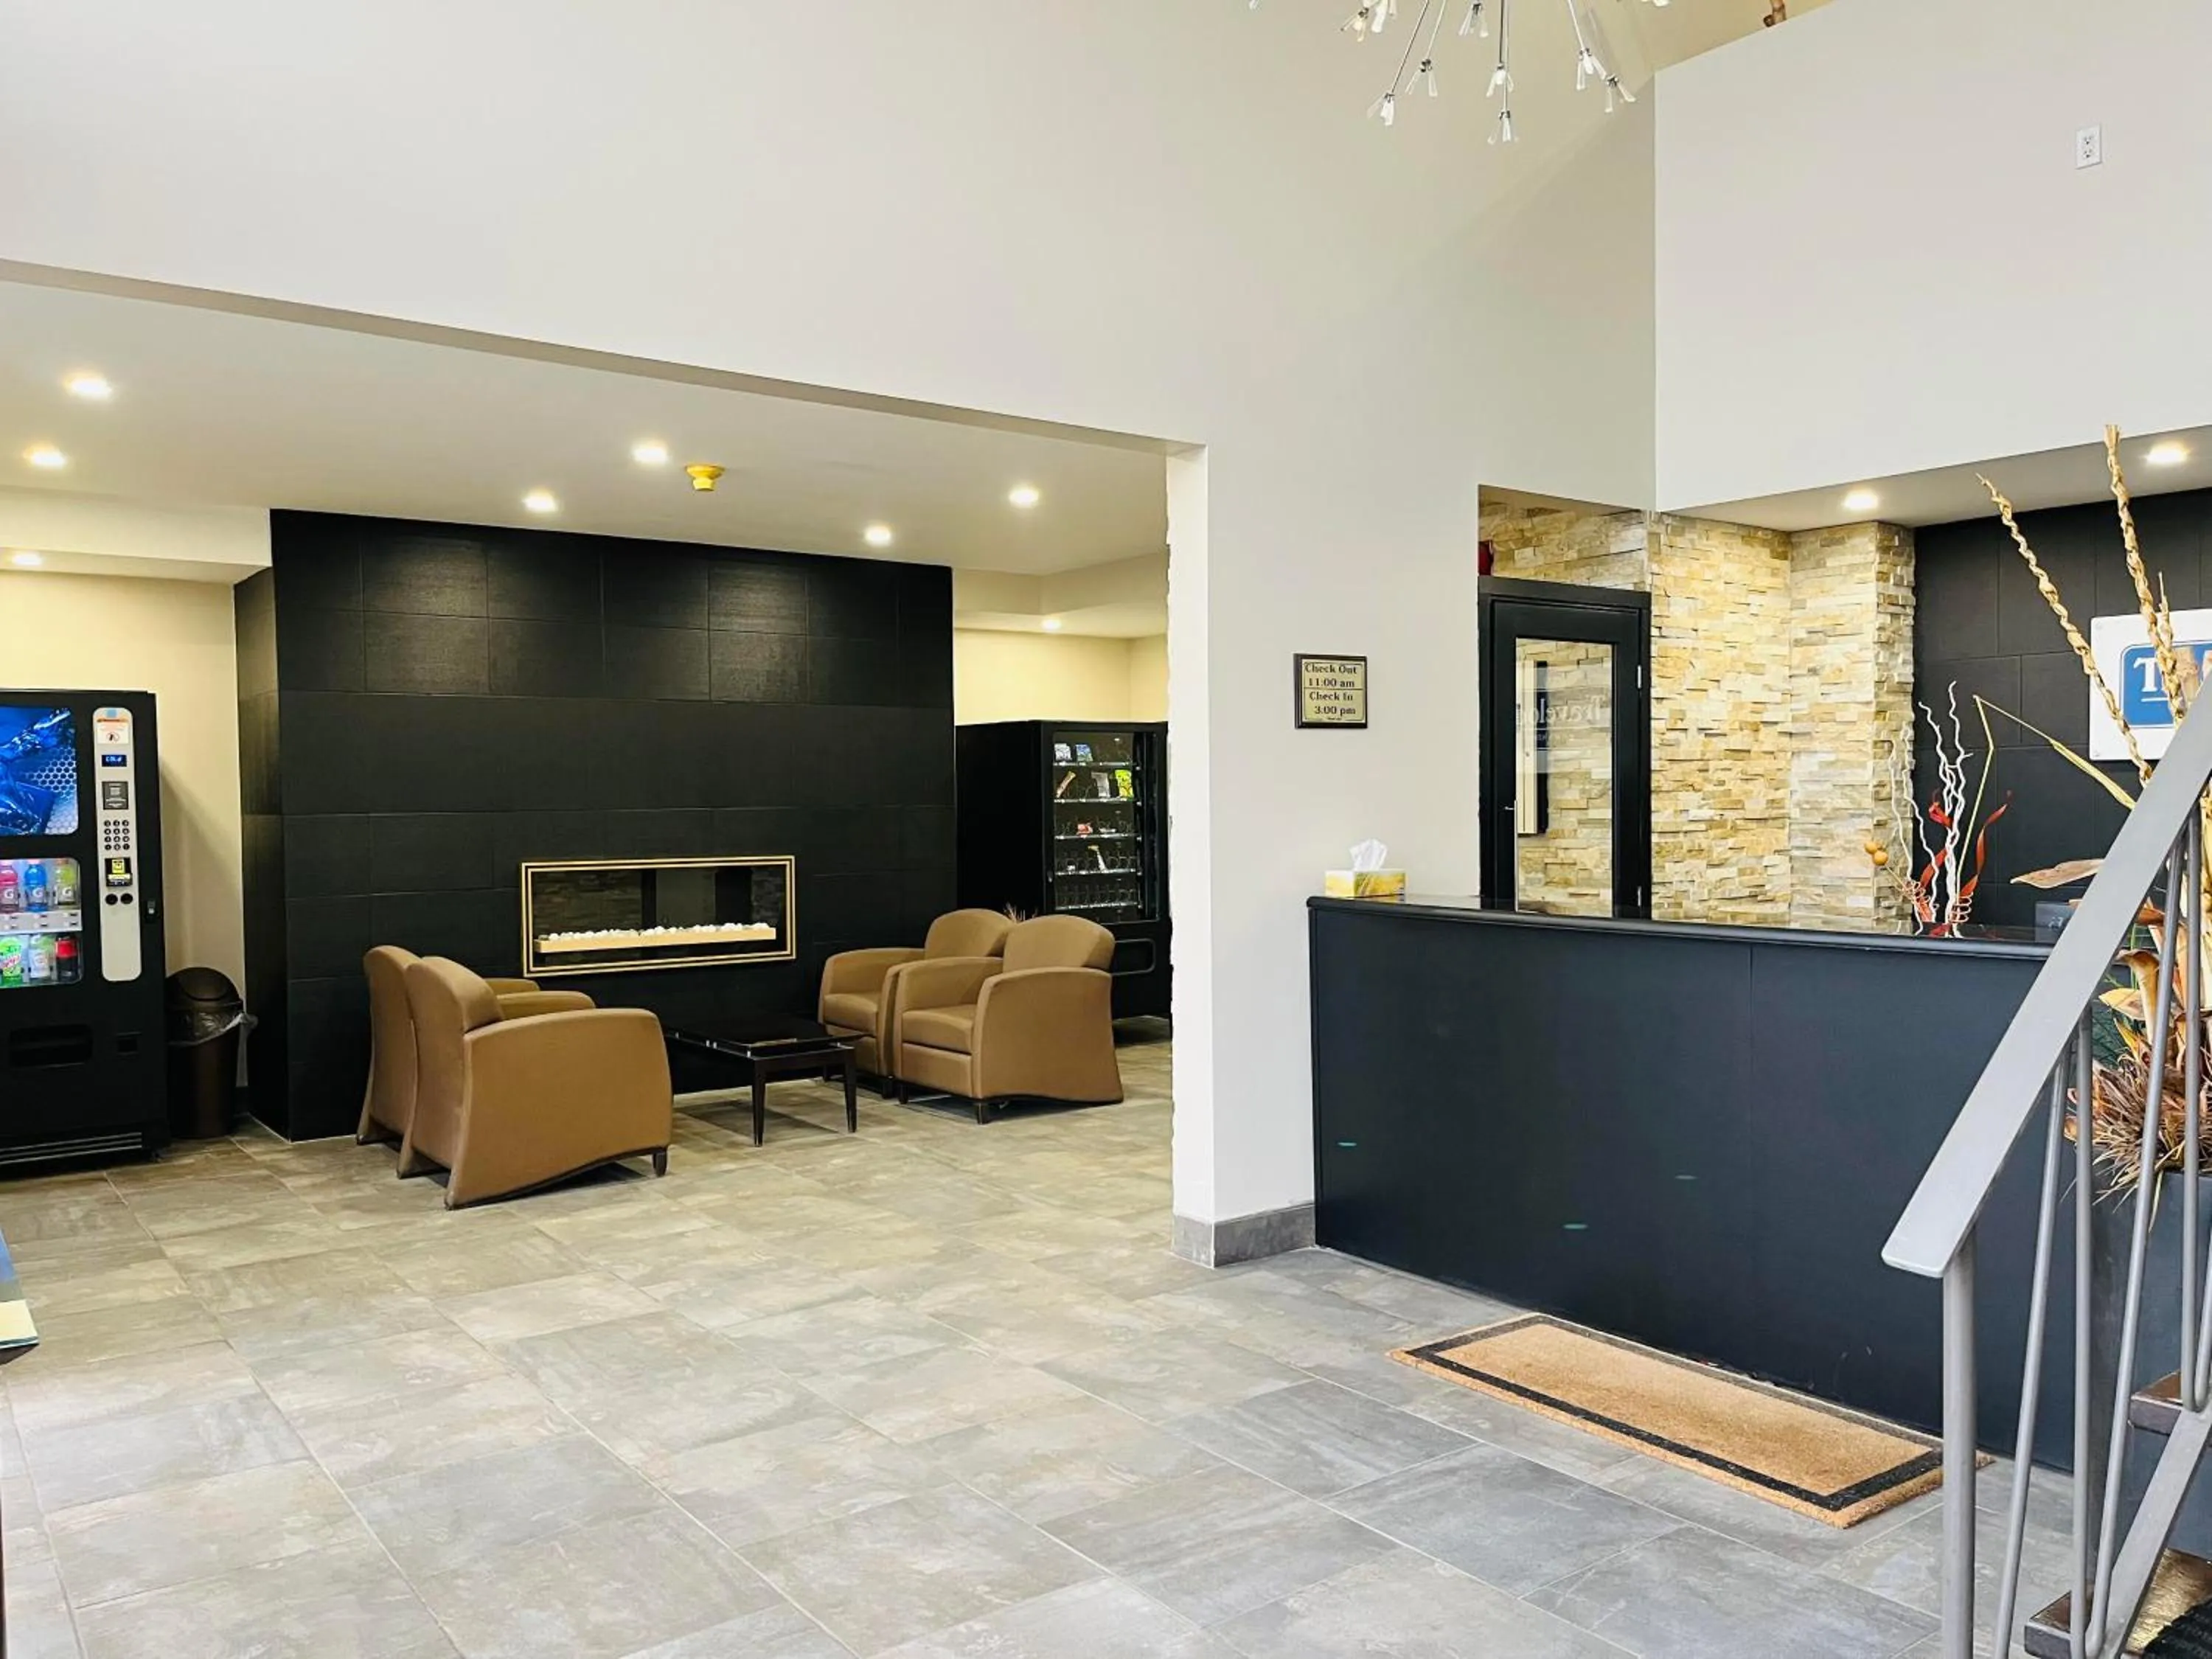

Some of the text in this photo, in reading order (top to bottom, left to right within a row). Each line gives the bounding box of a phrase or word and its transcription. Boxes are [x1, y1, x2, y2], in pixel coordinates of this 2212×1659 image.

[1305, 664, 1357, 674] Check Out
[1309, 691, 1353, 700] Check In
[1340, 708, 1356, 717] pm
